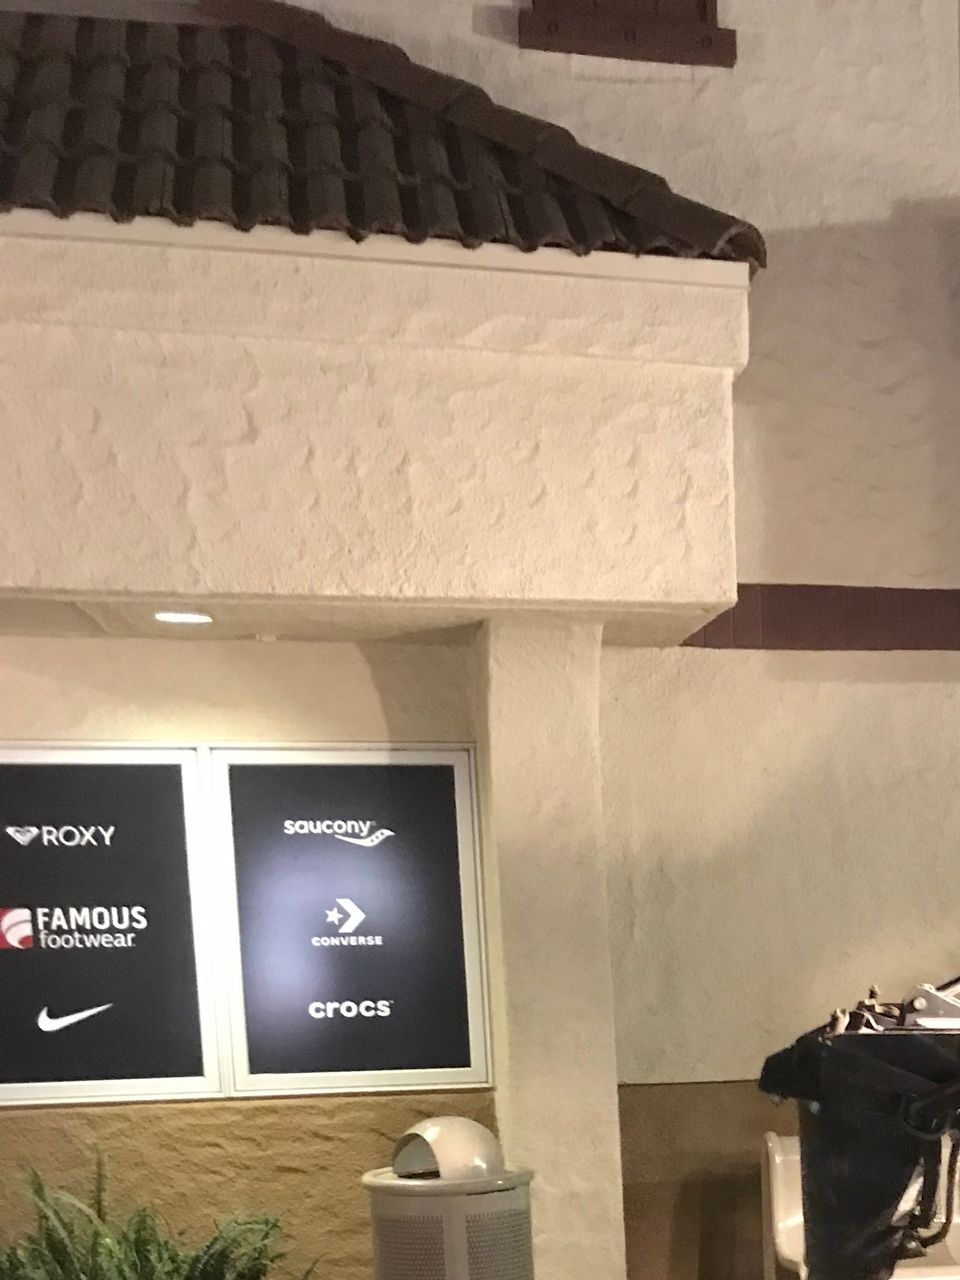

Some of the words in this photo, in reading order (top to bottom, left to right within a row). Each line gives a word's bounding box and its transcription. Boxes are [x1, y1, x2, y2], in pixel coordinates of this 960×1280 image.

[41, 825, 116, 847] ROXY
[283, 819, 371, 837] saucony
[36, 905, 148, 930] FAMOUS
[39, 929, 137, 949] footwear
[311, 935, 384, 947] CONVERSE
[308, 1000, 391, 1019] crocs
